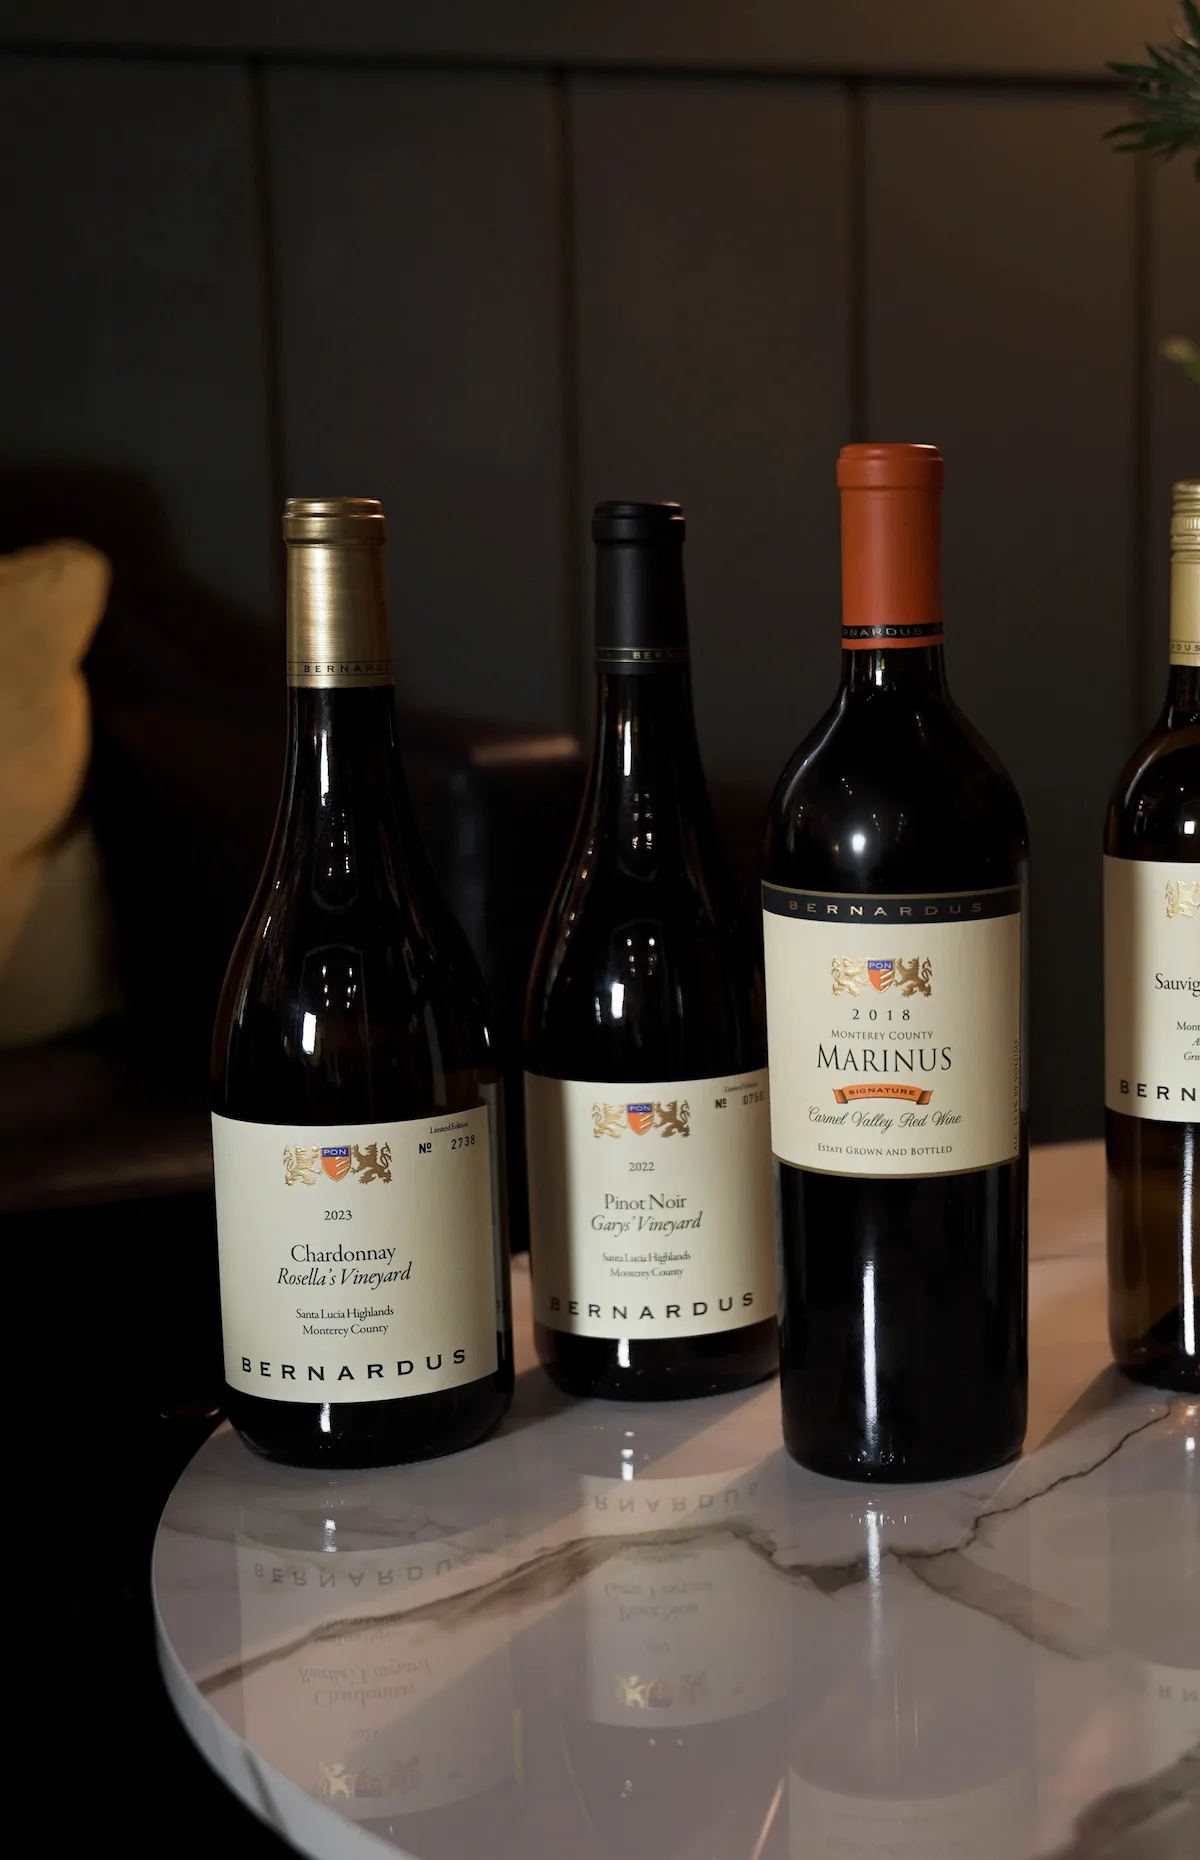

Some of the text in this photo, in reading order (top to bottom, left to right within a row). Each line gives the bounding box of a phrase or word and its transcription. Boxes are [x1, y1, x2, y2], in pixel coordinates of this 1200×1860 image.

[789, 900, 983, 916] BERNARDUS
[852, 1008, 910, 1021] 2018
[816, 1043, 952, 1072] MARINUS
[848, 1087, 916, 1096] SIGNATURE
[808, 1106, 962, 1134] Carmel Valley Red Wine
[451, 1134, 476, 1150] 2738
[885, 1147, 908, 1156] AND
[629, 1162, 655, 1172] 2022
[604, 1193, 687, 1210] Pinot Noir
[324, 1210, 352, 1221] 2023
[638, 1211, 703, 1237] Vineyard
[290, 1244, 396, 1266] Chardonnay
[648, 1251, 691, 1264] Highlands
[340, 1262, 412, 1290] Vineyard
[610, 1267, 684, 1280] Monterey County
[295, 1305, 394, 1322] Santa Lucia Highlands
[550, 1292, 755, 1319] BERNARDUS
[302, 1323, 389, 1337] Monterey County
[241, 1349, 466, 1381] BERNARDUS
